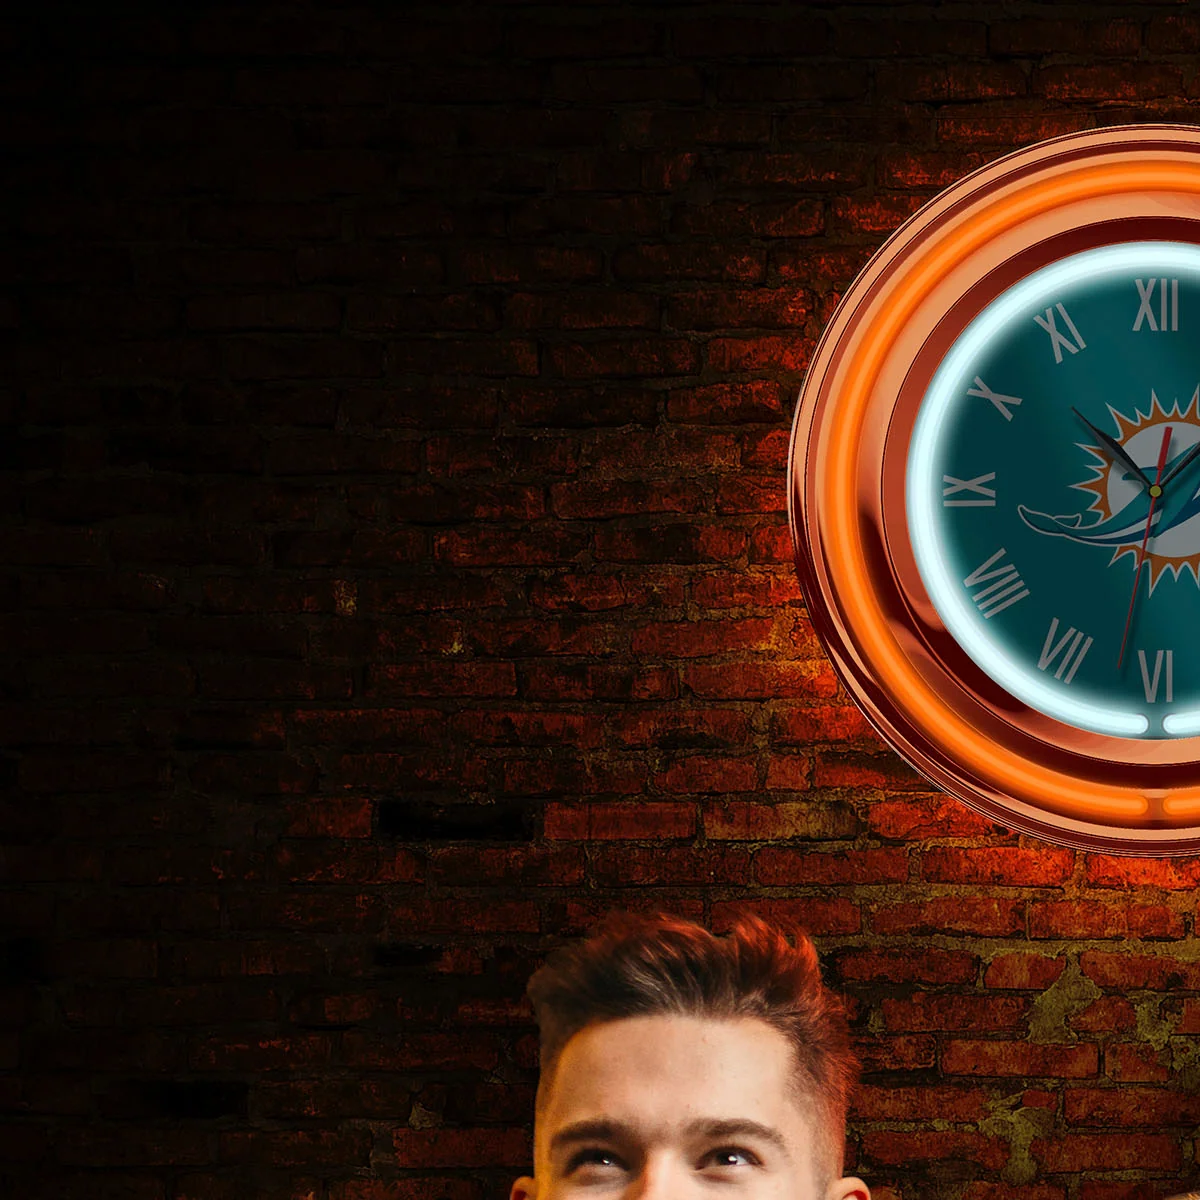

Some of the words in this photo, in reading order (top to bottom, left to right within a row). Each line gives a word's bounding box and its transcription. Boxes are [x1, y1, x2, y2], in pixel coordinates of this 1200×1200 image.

[1132, 277, 1179, 332] XII
[1032, 302, 1087, 364] XI
[966, 375, 1023, 422] X
[943, 471, 996, 507] IX
[963, 548, 1030, 620] VIII
[1036, 617, 1094, 685] VII
[1138, 649, 1173, 704] VI
